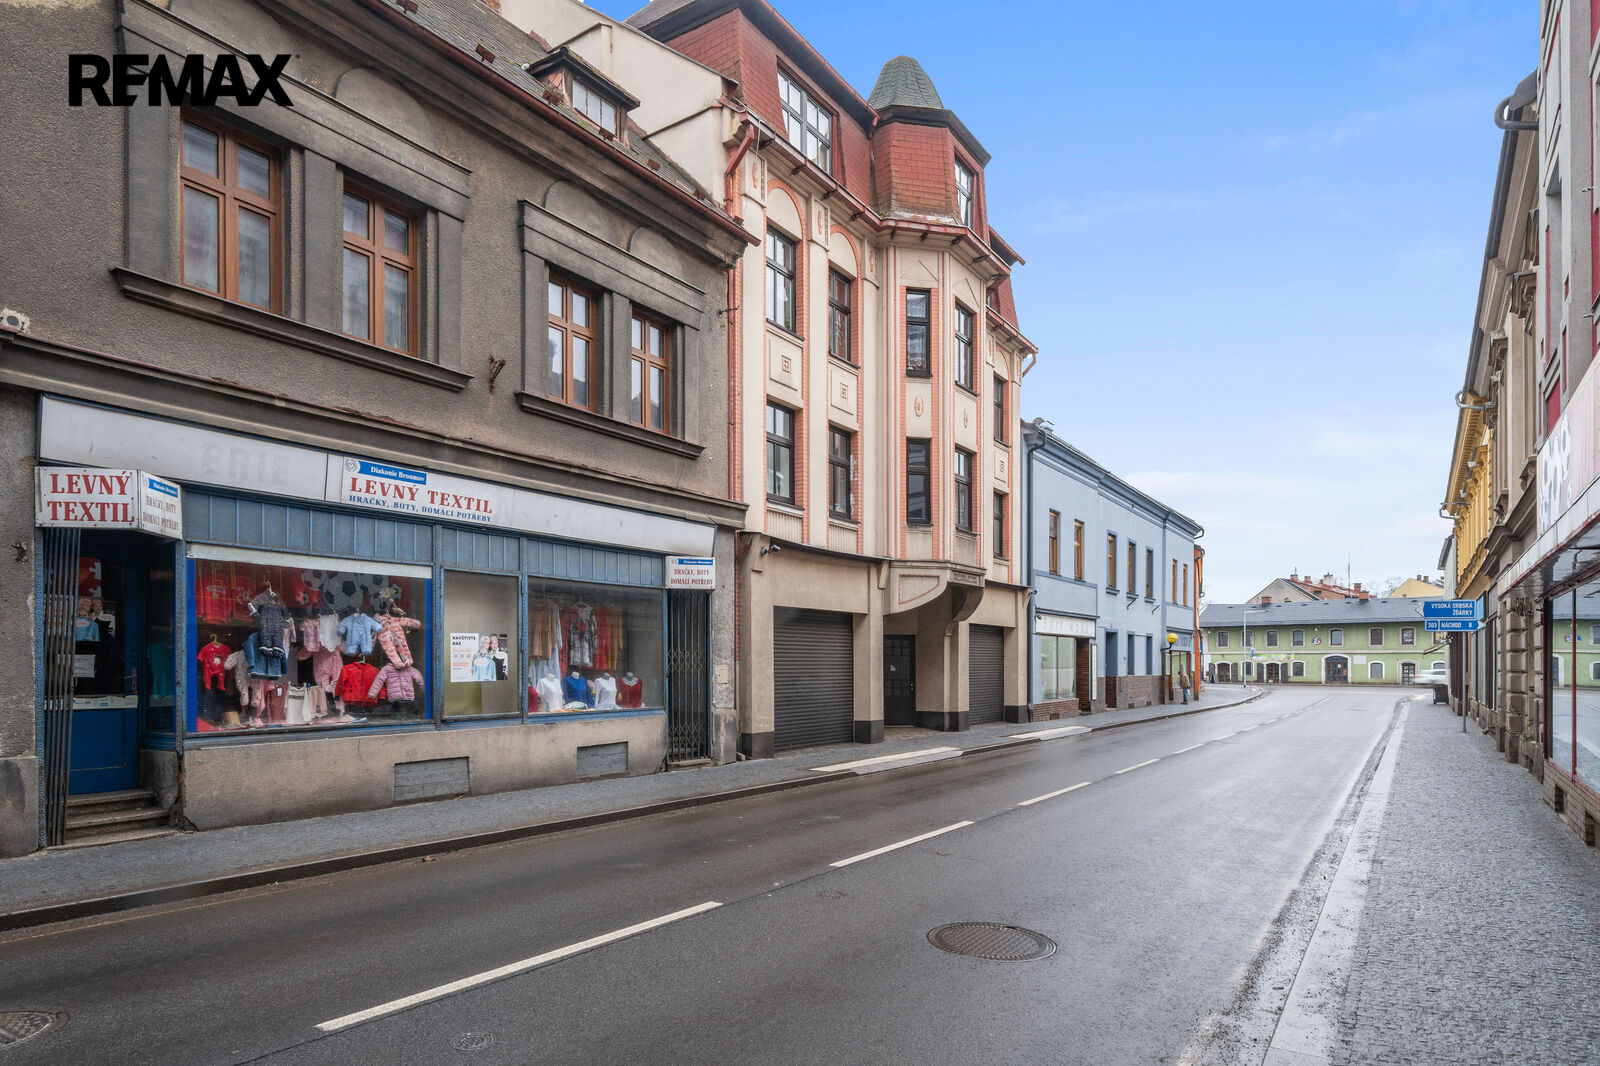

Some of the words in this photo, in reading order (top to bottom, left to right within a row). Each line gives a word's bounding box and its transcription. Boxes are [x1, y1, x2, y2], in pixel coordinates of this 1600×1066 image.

[50, 470, 131, 496] LEVNÝ
[371, 466, 397, 477] Diakonie
[398, 472, 424, 481] Broumov
[350, 477, 419, 501] LEVNÝ
[428, 490, 492, 513] TEXTIL
[47, 501, 135, 523] TEXTIL
[393, 501, 419, 513] BOTY,
[456, 511, 492, 523] POTŘEBY
